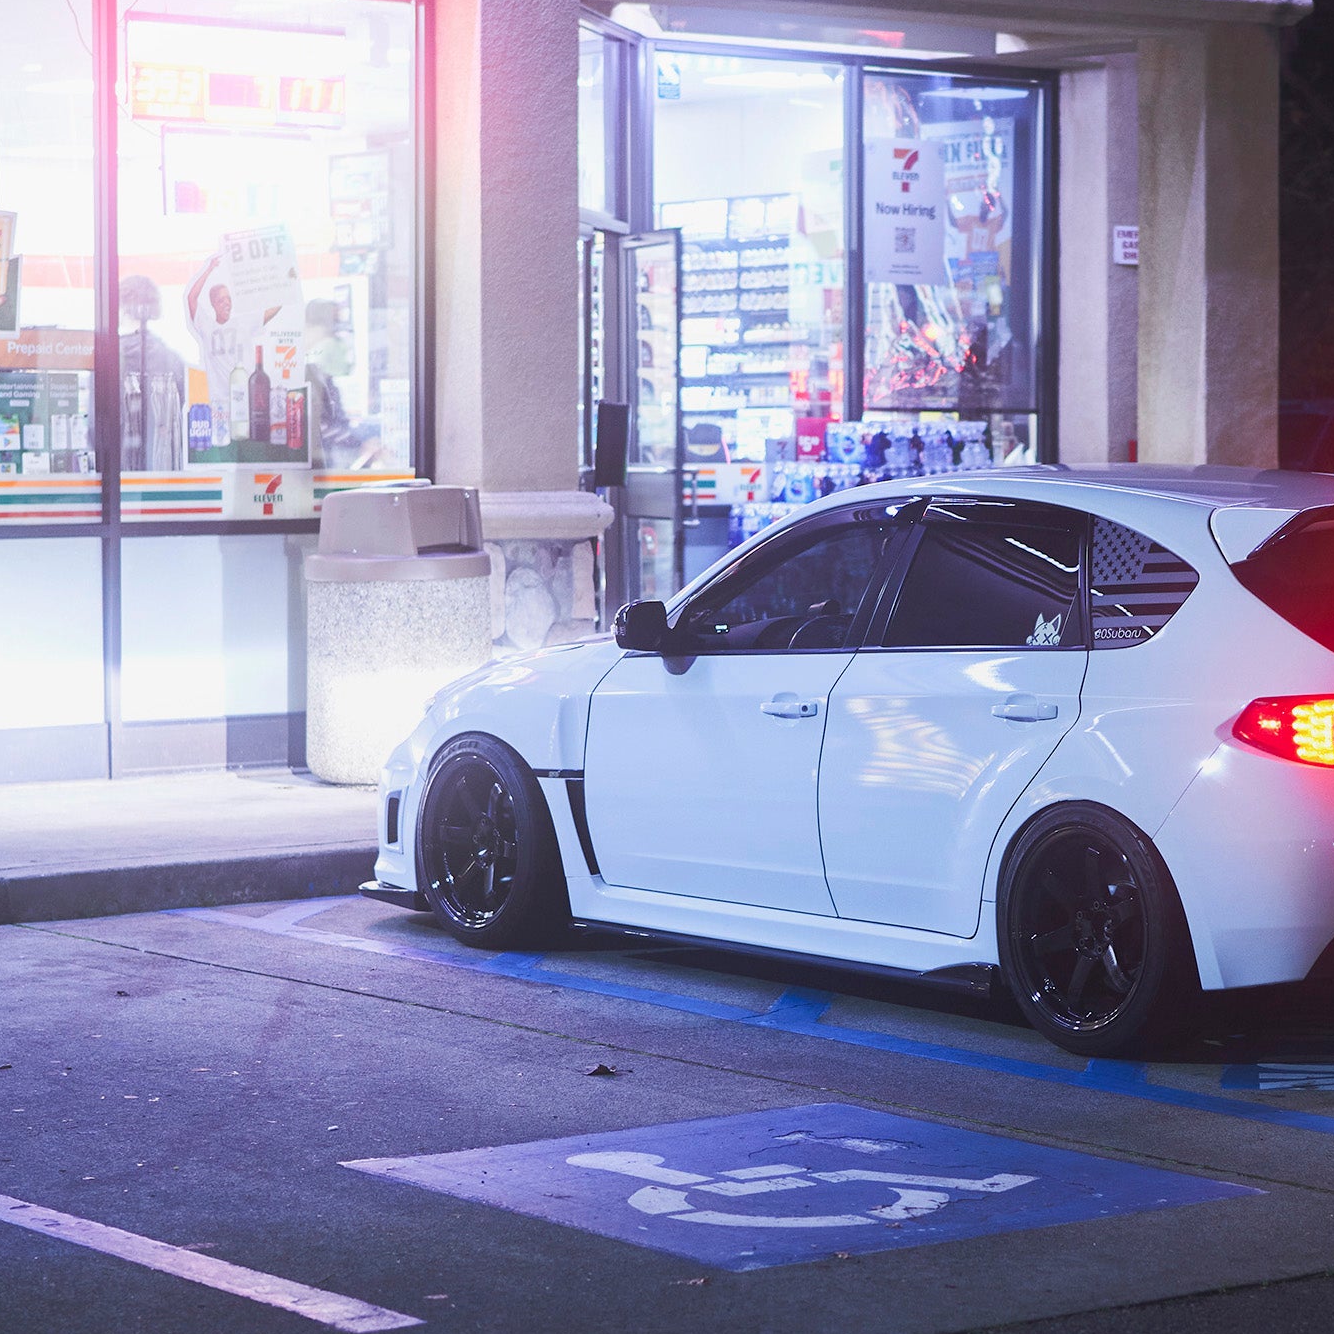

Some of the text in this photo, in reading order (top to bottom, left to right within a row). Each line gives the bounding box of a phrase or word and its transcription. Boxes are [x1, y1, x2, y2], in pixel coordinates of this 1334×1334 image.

[876, 202, 937, 221] Now Hiring
[7, 341, 53, 356] Prepaid
